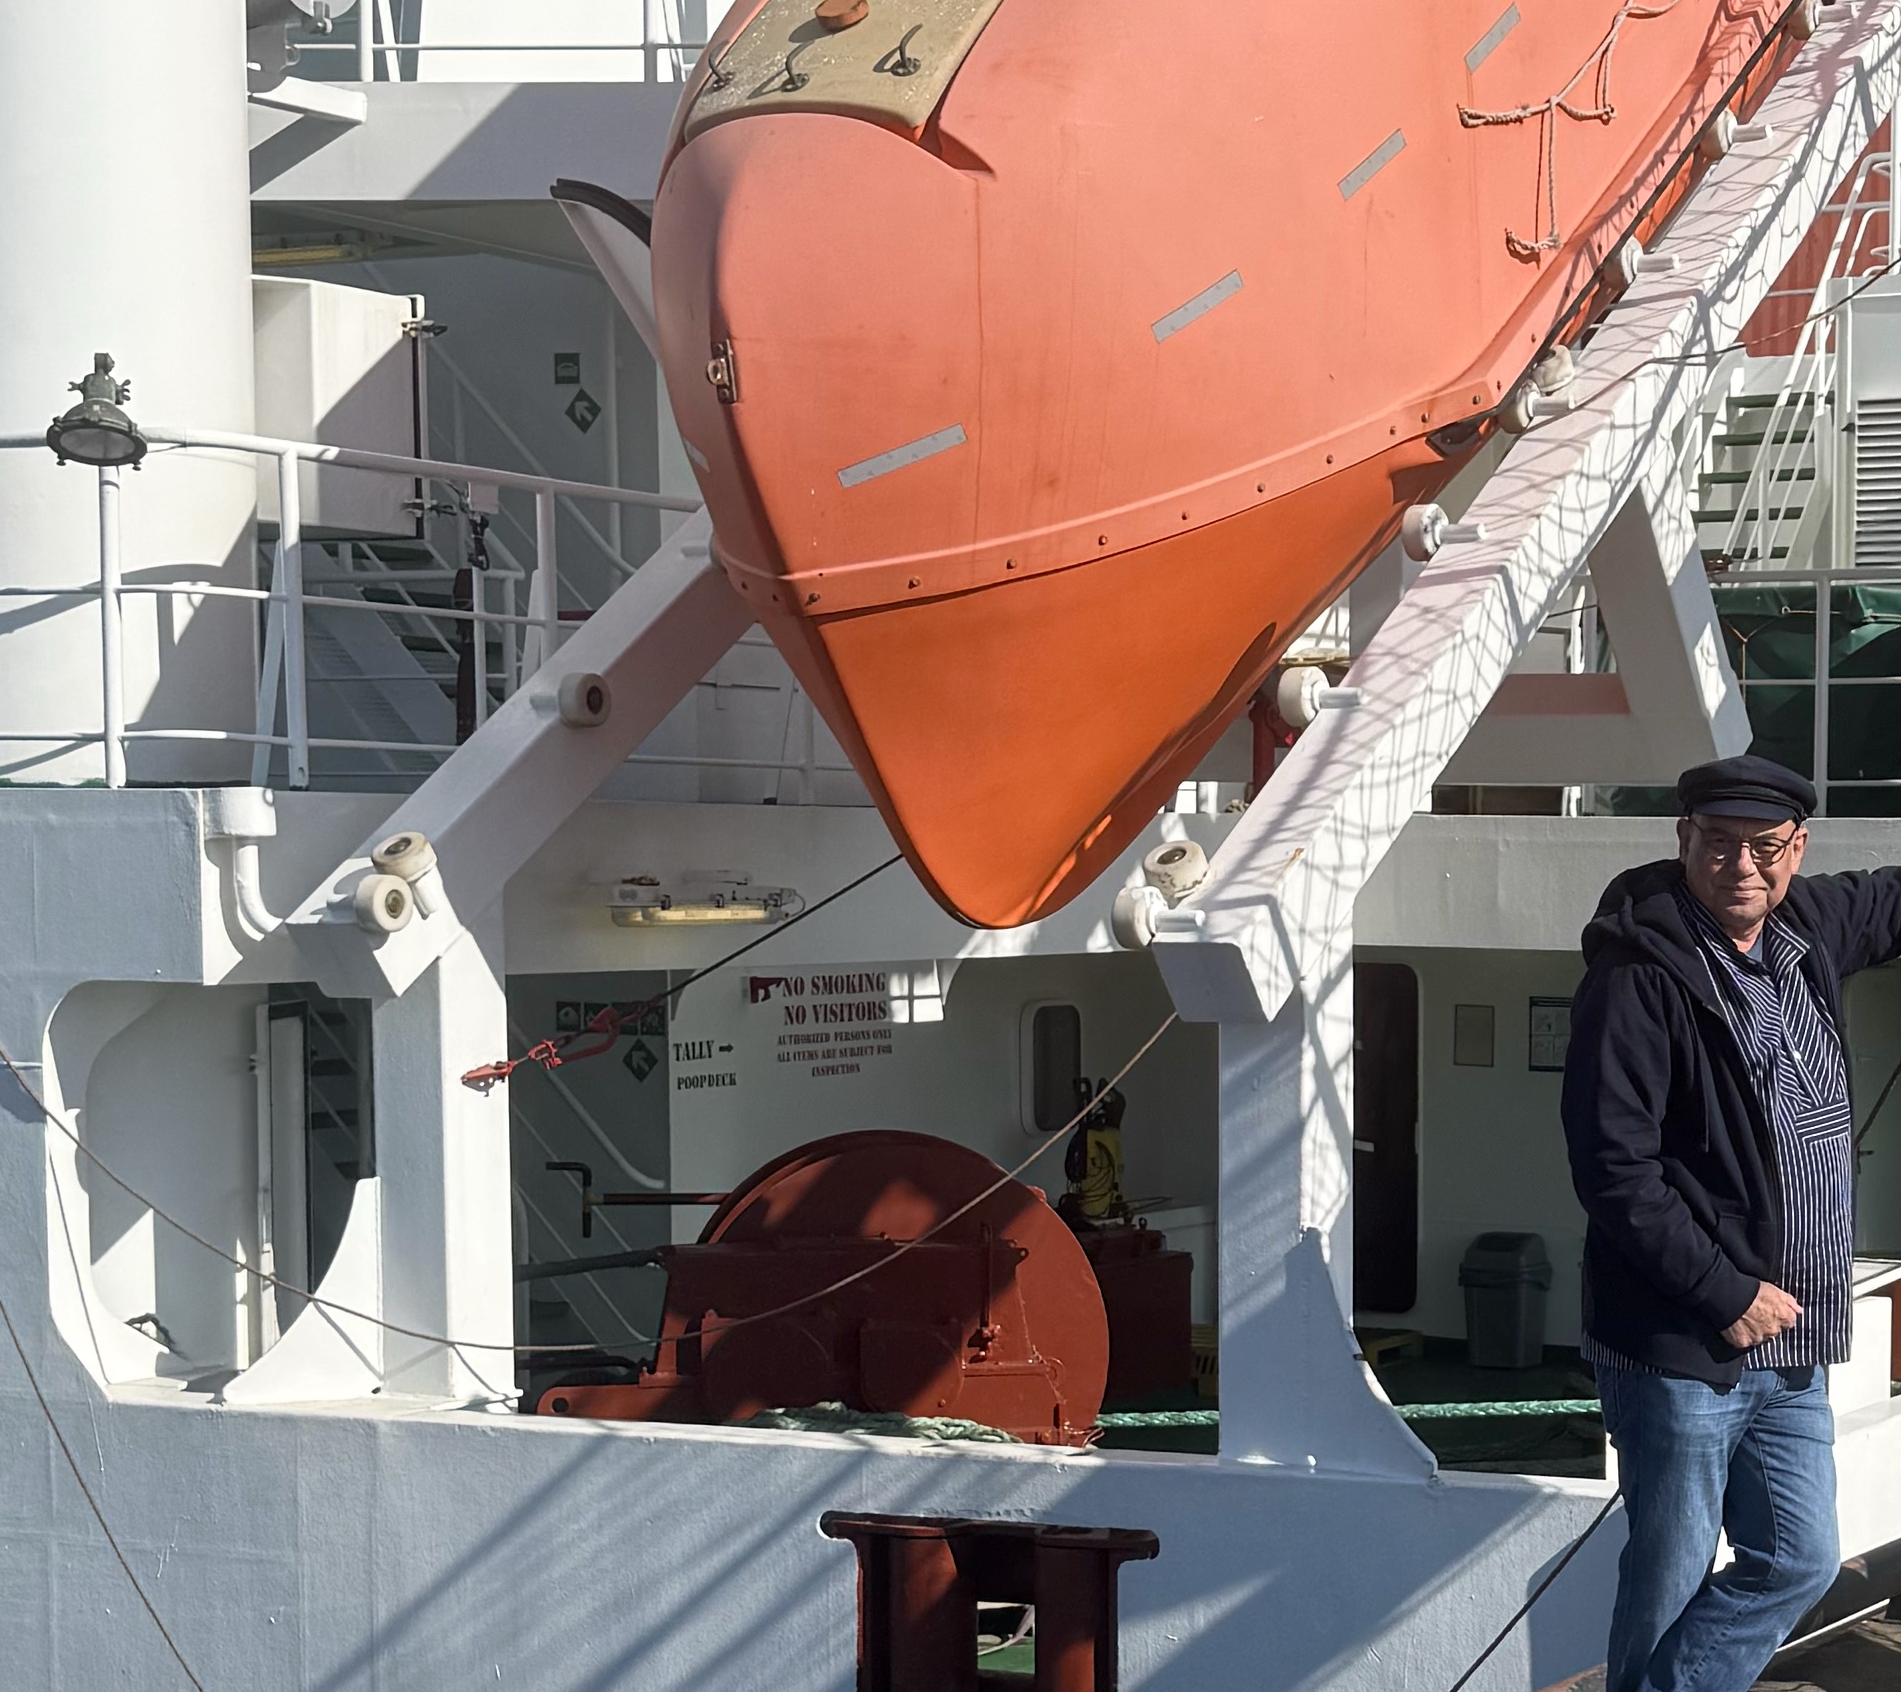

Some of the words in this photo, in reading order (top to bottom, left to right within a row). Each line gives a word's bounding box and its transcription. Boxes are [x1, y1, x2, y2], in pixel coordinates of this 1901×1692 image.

[782, 975, 805, 997] NO
[811, 973, 887, 996] SMOKING
[784, 1004, 807, 1026] NO
[812, 1000, 888, 1024] VISITORS
[777, 1032, 830, 1046] AUTHORIZED
[834, 1029, 871, 1043] PERSONS
[872, 1028, 892, 1041] ONLY
[672, 1040, 715, 1062] TALLY
[777, 1051, 790, 1062] ALL
[793, 1049, 819, 1062] ITEMS
[821, 1048, 837, 1060] ARE
[838, 1045, 875, 1058] SUBJECT
[876, 1043, 893, 1055] FOR
[811, 1063, 861, 1077] INSPECTION
